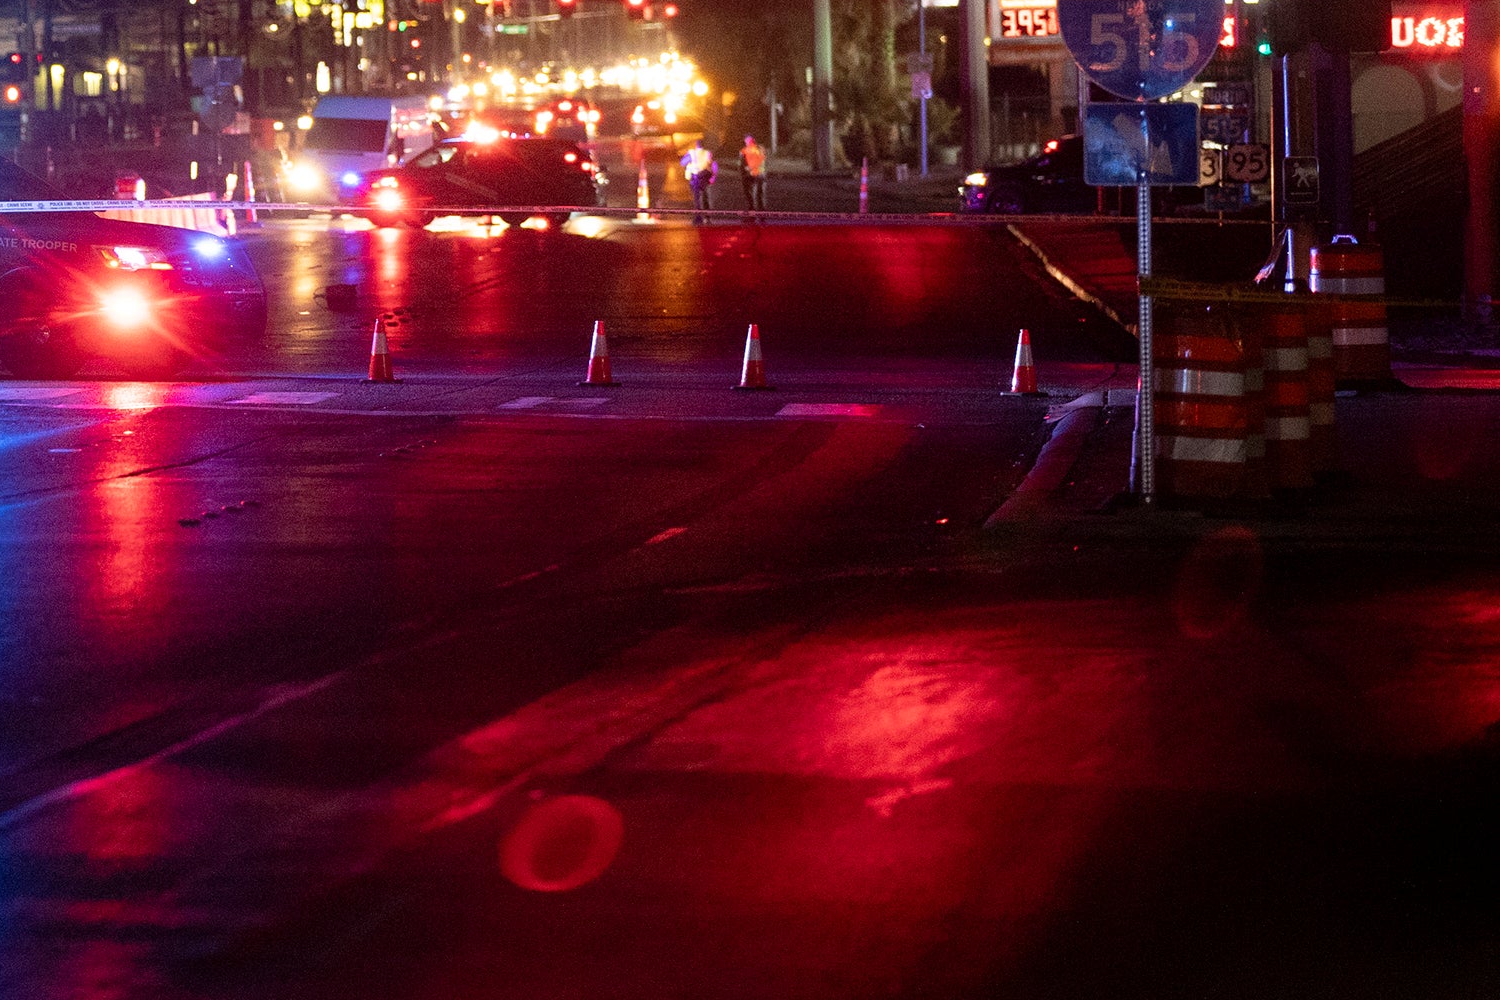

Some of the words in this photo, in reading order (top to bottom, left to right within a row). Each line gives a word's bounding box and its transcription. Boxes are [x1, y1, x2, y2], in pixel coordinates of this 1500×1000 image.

[1089, 13, 1199, 72] 515
[1206, 118, 1242, 139] 515
[1232, 150, 1264, 174] 95
[19, 238, 78, 253] TROOPER
